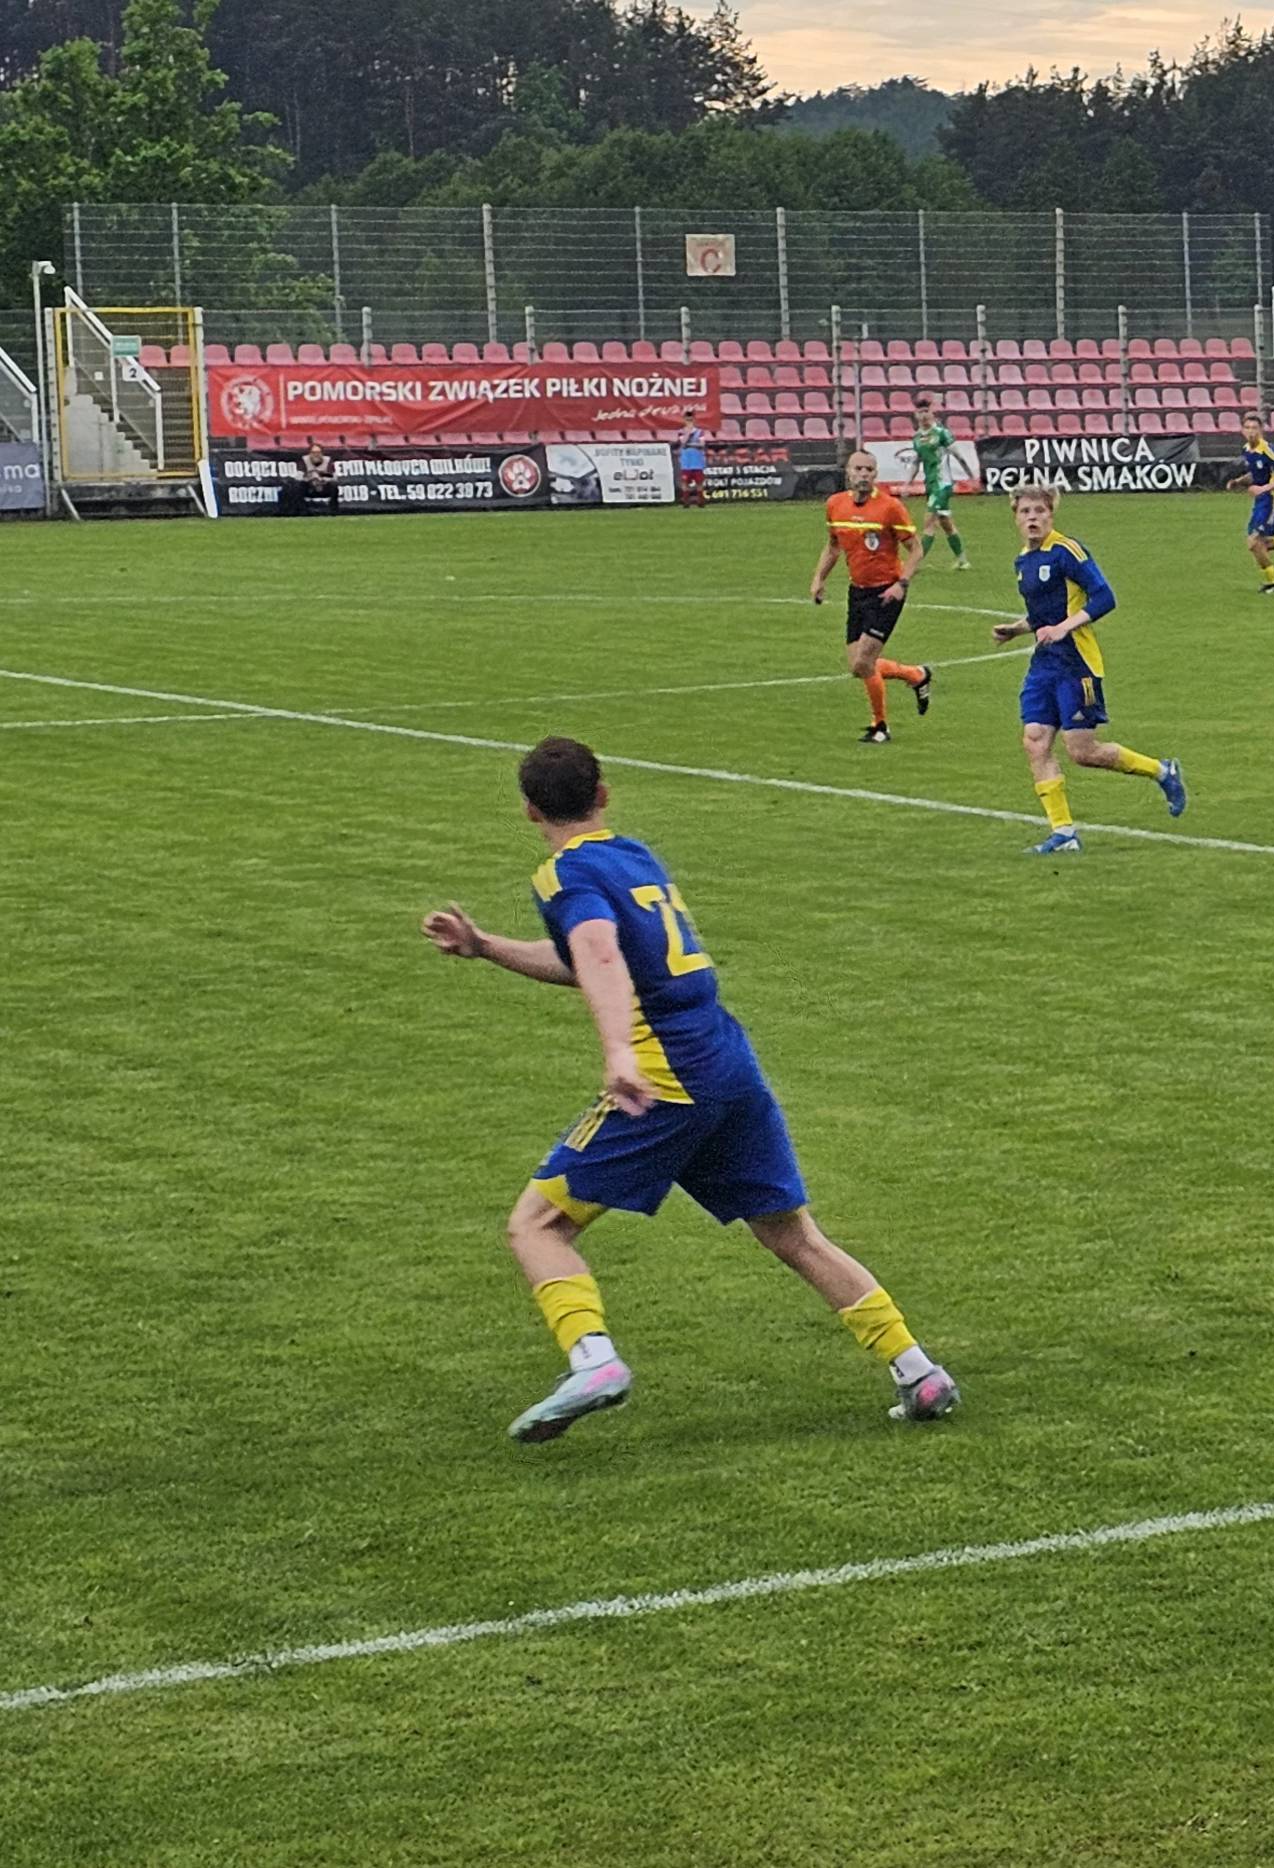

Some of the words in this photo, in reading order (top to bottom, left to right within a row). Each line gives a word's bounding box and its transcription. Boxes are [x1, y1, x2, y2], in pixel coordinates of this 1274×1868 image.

[701, 249, 721, 273] C
[129, 368, 138, 378] 2
[287, 381, 422, 401] POMORSKI
[428, 377, 541, 403] ZWIĄZEK
[546, 377, 608, 397] PIŁKI
[613, 372, 708, 397] NOŻNEJ
[1024, 436, 1155, 464] PIWNICA
[3, 463, 40, 480] ma
[986, 466, 1073, 493] PEŁNA
[1078, 459, 1197, 491] SMAKÓW
[475, 481, 493, 498] 73
